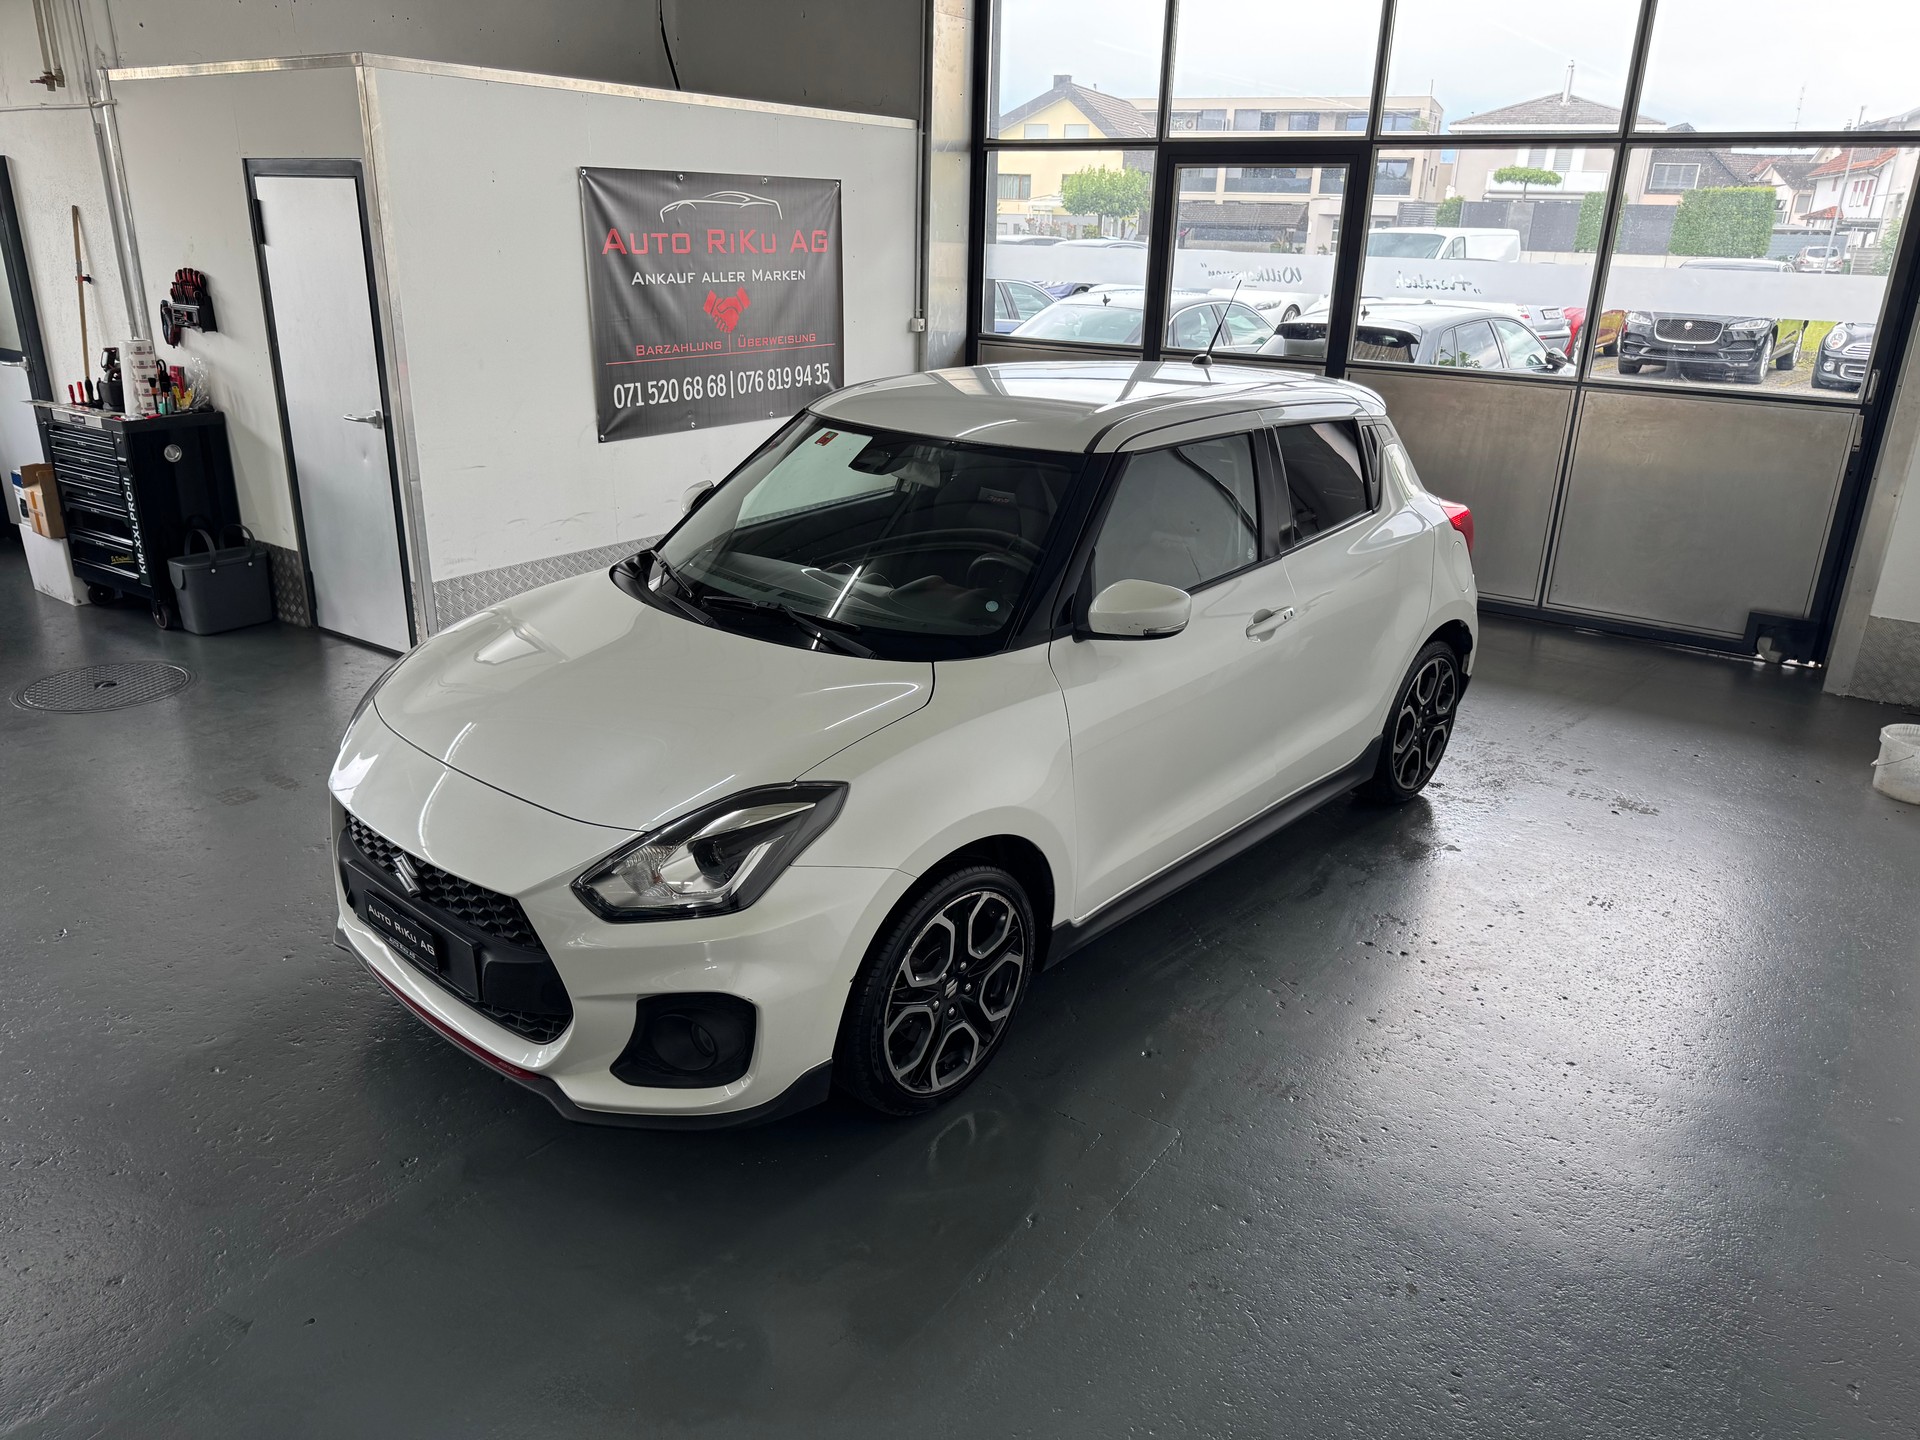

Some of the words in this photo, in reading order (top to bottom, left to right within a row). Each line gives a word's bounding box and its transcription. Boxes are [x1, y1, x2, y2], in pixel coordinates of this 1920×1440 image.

[602, 228, 691, 255] AUTO
[790, 229, 828, 253] AG
[631, 271, 696, 285] ANKAUF
[701, 271, 745, 283] ALLER
[752, 269, 806, 281] MARKEN
[636, 340, 722, 356] BARZAHLUNG
[737, 333, 816, 348] ÜBERWEISUNG
[613, 383, 645, 409] 071
[648, 378, 679, 405] 520
[682, 376, 703, 400] 68
[707, 373, 727, 397] 68
[737, 370, 764, 394] 076
[767, 367, 791, 391] 819
[795, 365, 812, 387] 94
[814, 363, 830, 384] 35
[368, 904, 392, 926] AUTO
[420, 940, 435, 956] AG
